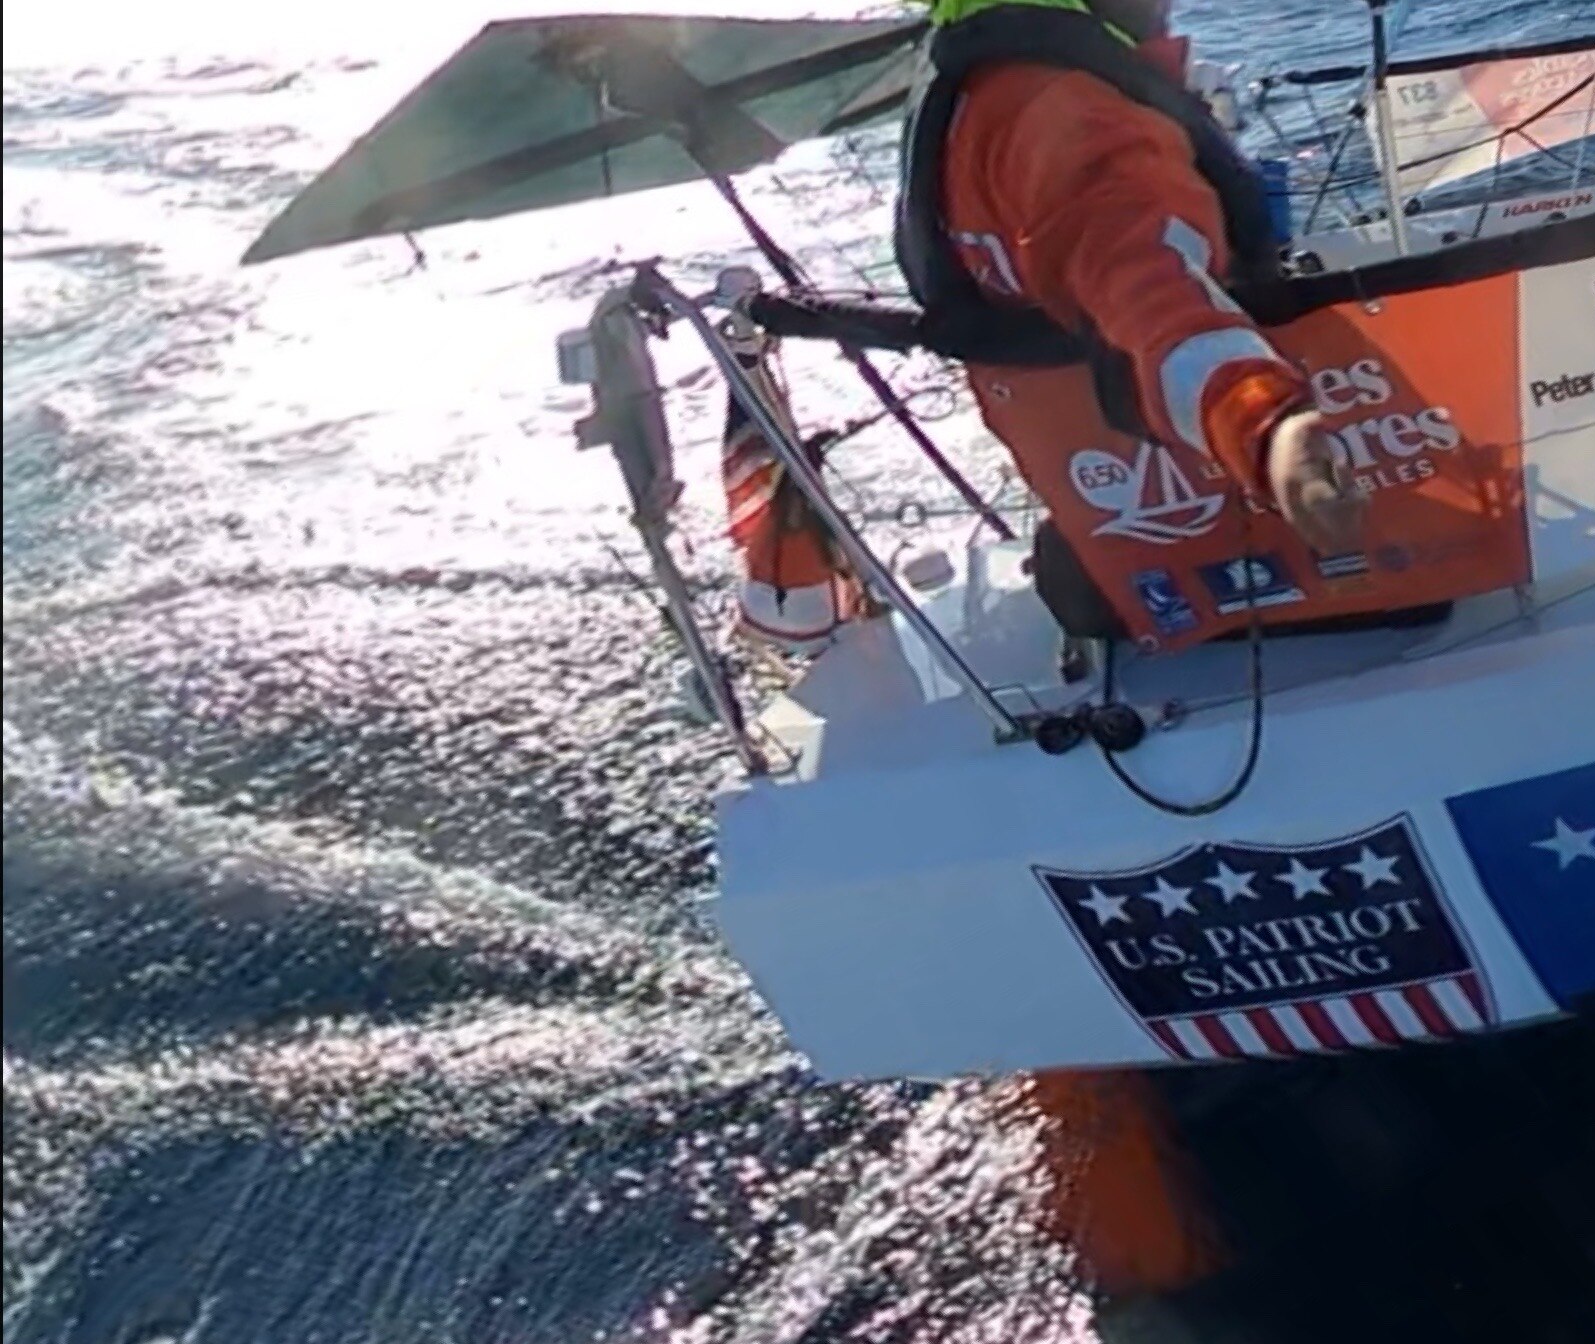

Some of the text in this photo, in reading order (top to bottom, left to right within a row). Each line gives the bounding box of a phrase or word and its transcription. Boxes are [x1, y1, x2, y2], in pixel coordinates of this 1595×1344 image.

[1310, 358, 1394, 415] es
[1529, 367, 1595, 407] Peter
[1354, 458, 1436, 493] BLES
[1103, 898, 1423, 971] U.S. PATRIOT
[1182, 944, 1392, 999] SAILING
